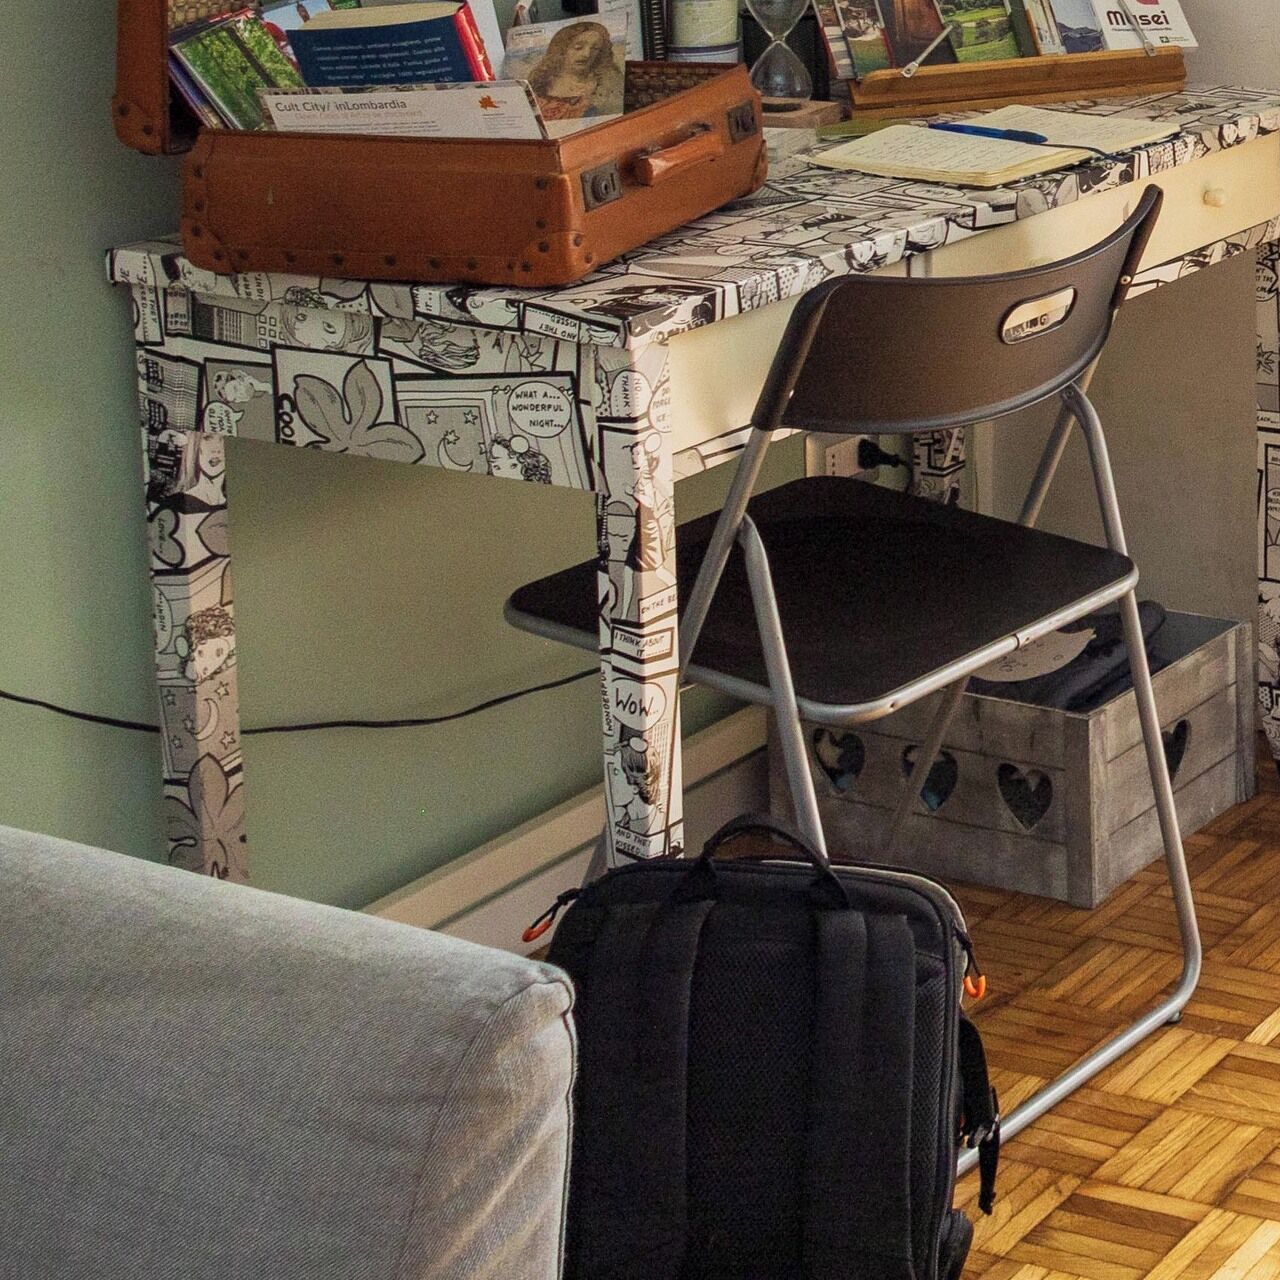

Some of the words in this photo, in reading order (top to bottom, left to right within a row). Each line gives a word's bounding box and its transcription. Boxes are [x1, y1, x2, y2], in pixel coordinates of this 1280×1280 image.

[275, 102, 300, 112] Cult
[335, 99, 407, 111] inLombardia
[515, 390, 538, 399] WHAT
[621, 375, 631, 408] THANK
[511, 403, 564, 412] WONDERFUL
[619, 633, 641, 649] THINK
[601, 670, 614, 732] WONDERFUL
[616, 829, 631, 839] AND
[633, 835, 652, 847] THEY
